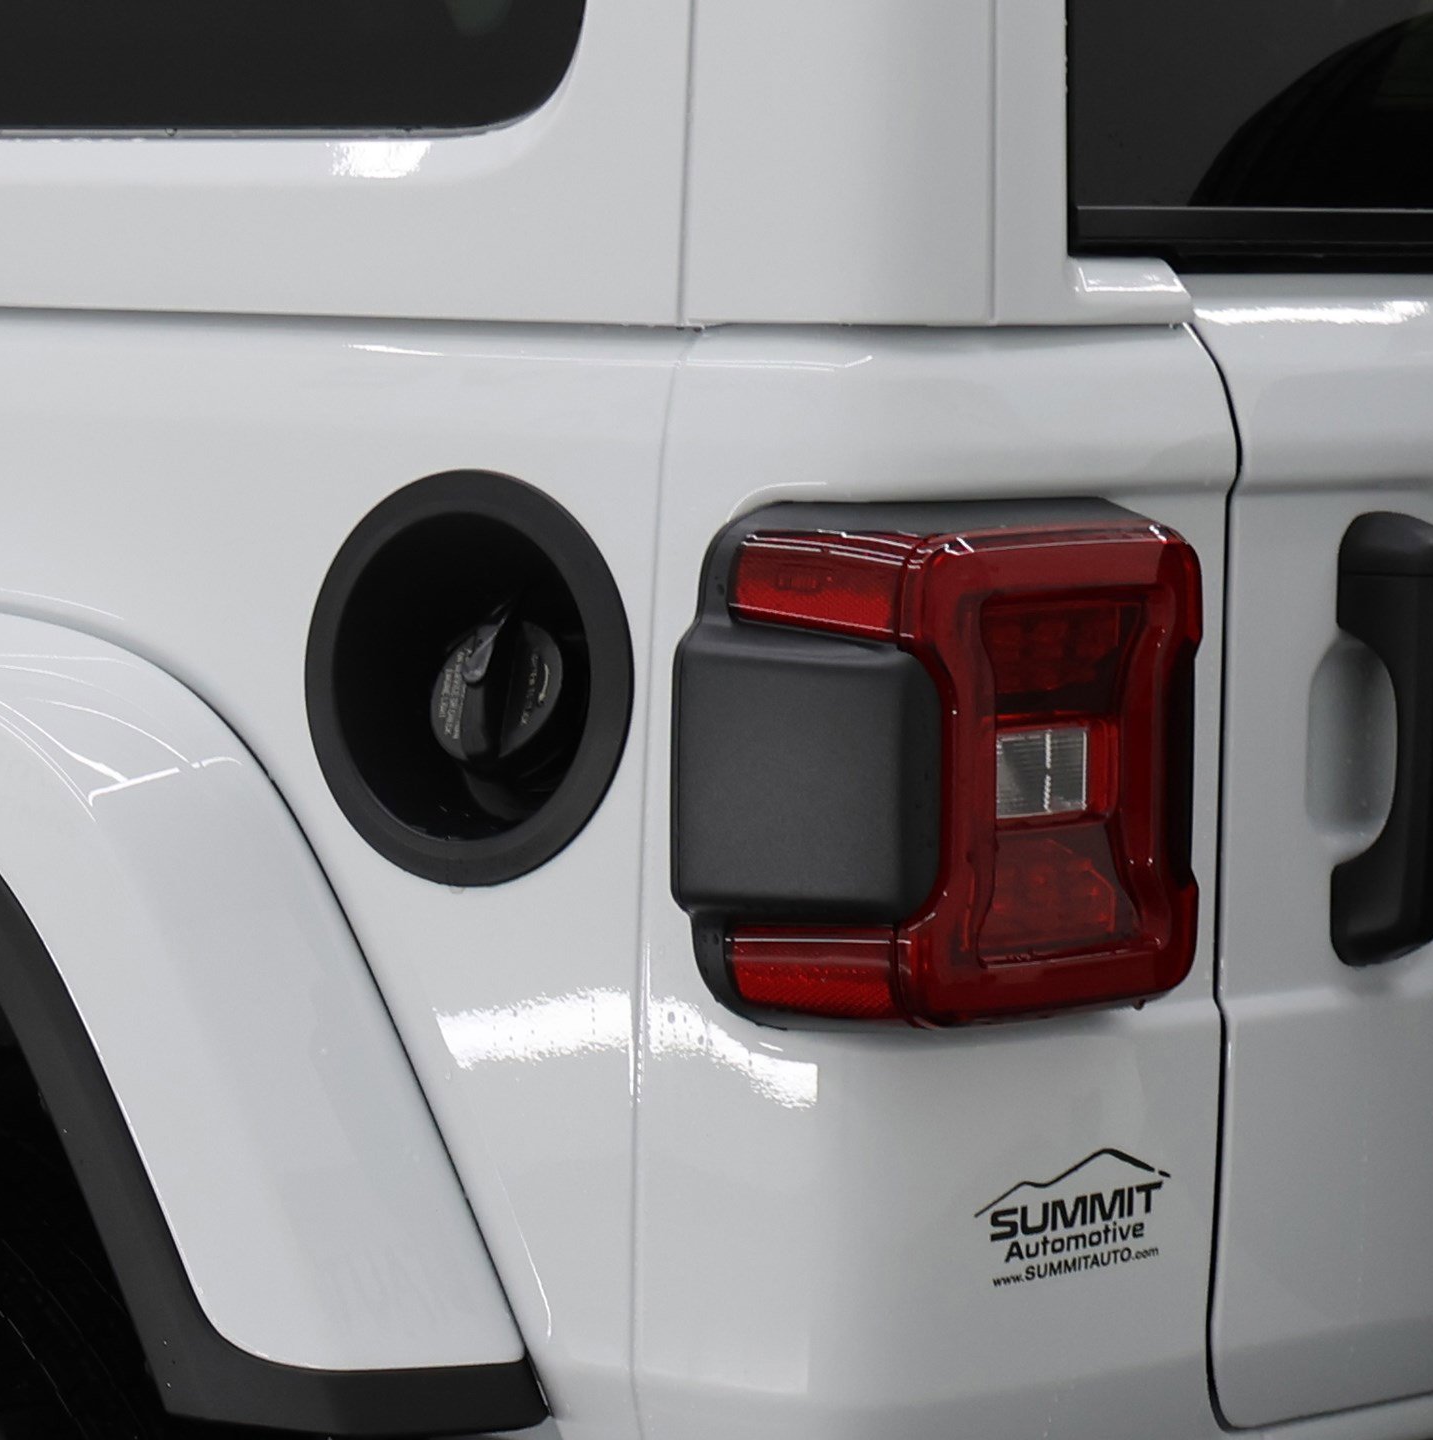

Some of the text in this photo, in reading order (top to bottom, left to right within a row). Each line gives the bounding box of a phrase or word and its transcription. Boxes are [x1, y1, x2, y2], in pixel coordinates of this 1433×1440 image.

[990, 1180, 1164, 1242] SUMMIT
[1004, 1221, 1145, 1263] Automotive
[992, 1246, 1160, 1288] www.SUMMITAUTO.com
